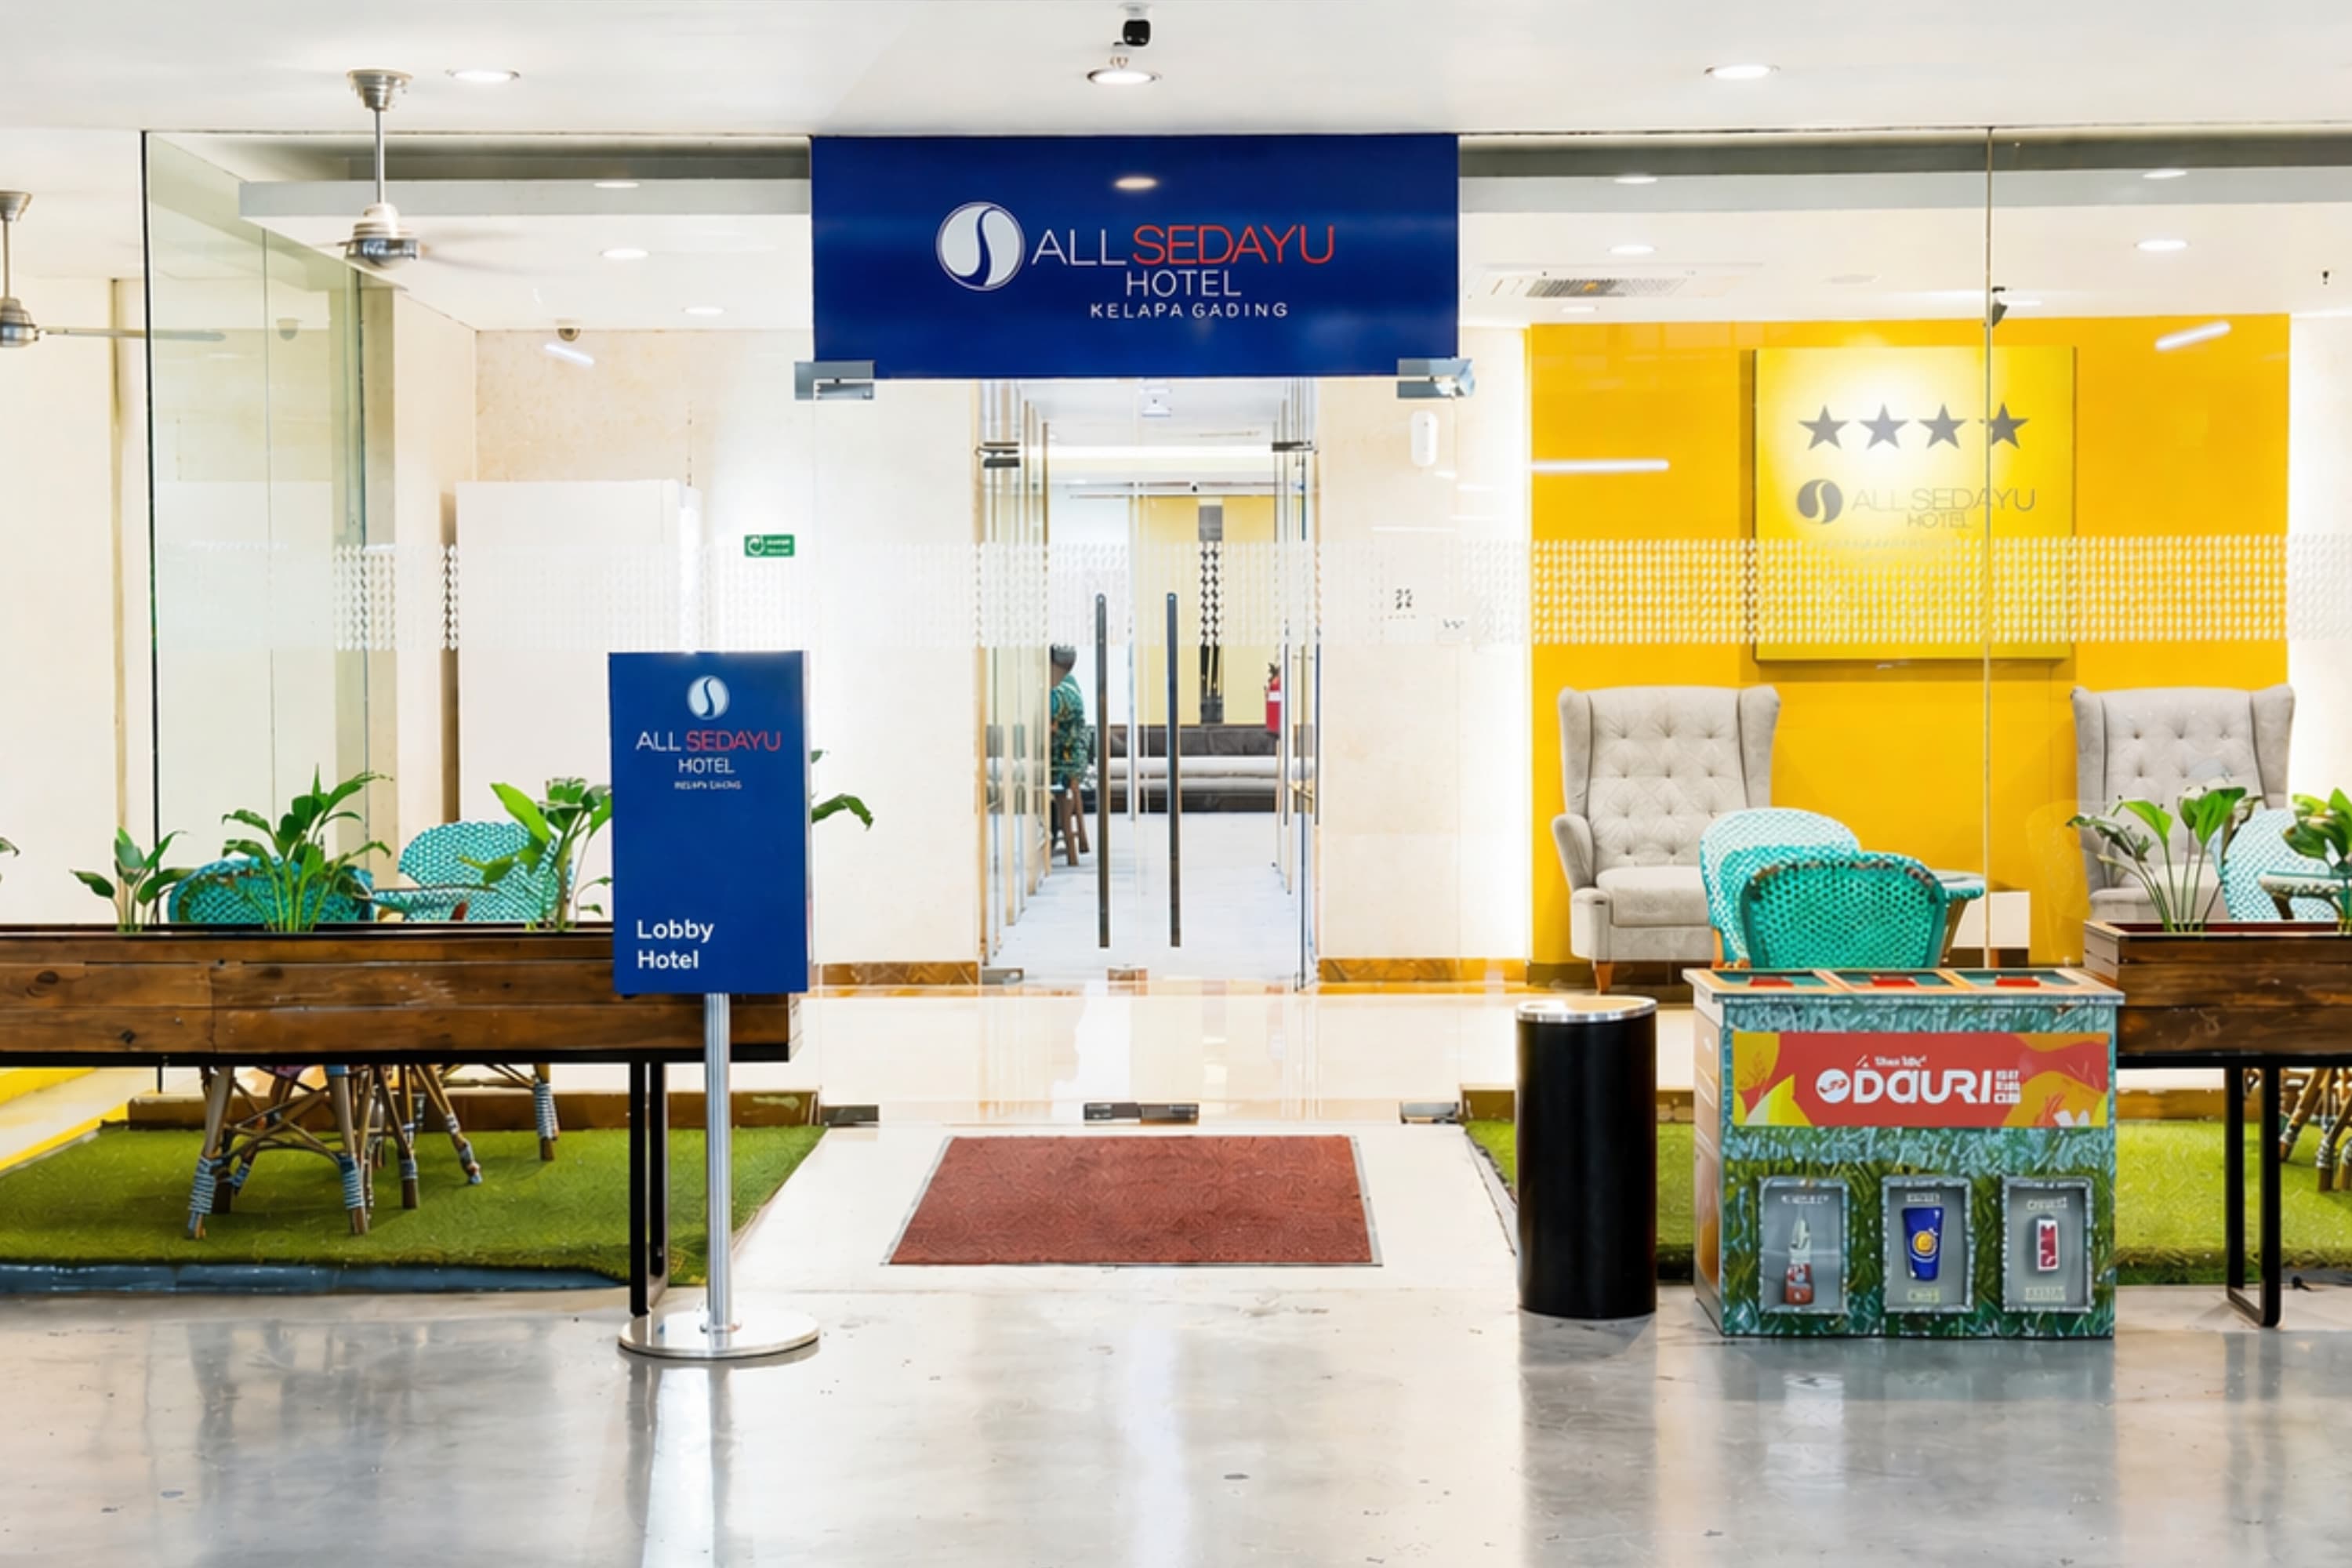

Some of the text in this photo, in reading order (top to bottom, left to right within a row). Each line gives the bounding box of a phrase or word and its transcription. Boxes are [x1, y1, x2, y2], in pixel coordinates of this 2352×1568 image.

[1031, 224, 1334, 265] ALL SEDAYU
[1126, 270, 1241, 296] HOTEL
[1091, 303, 1288, 318] KELAPA GADING
[1851, 488, 2036, 512] ALL SEDAYU
[1907, 511, 1973, 529] HOTEL
[636, 731, 781, 753] ALL SEDAYU
[677, 757, 735, 775] HOTEL
[636, 919, 714, 942] Lobby
[637, 949, 699, 970] Hotel
